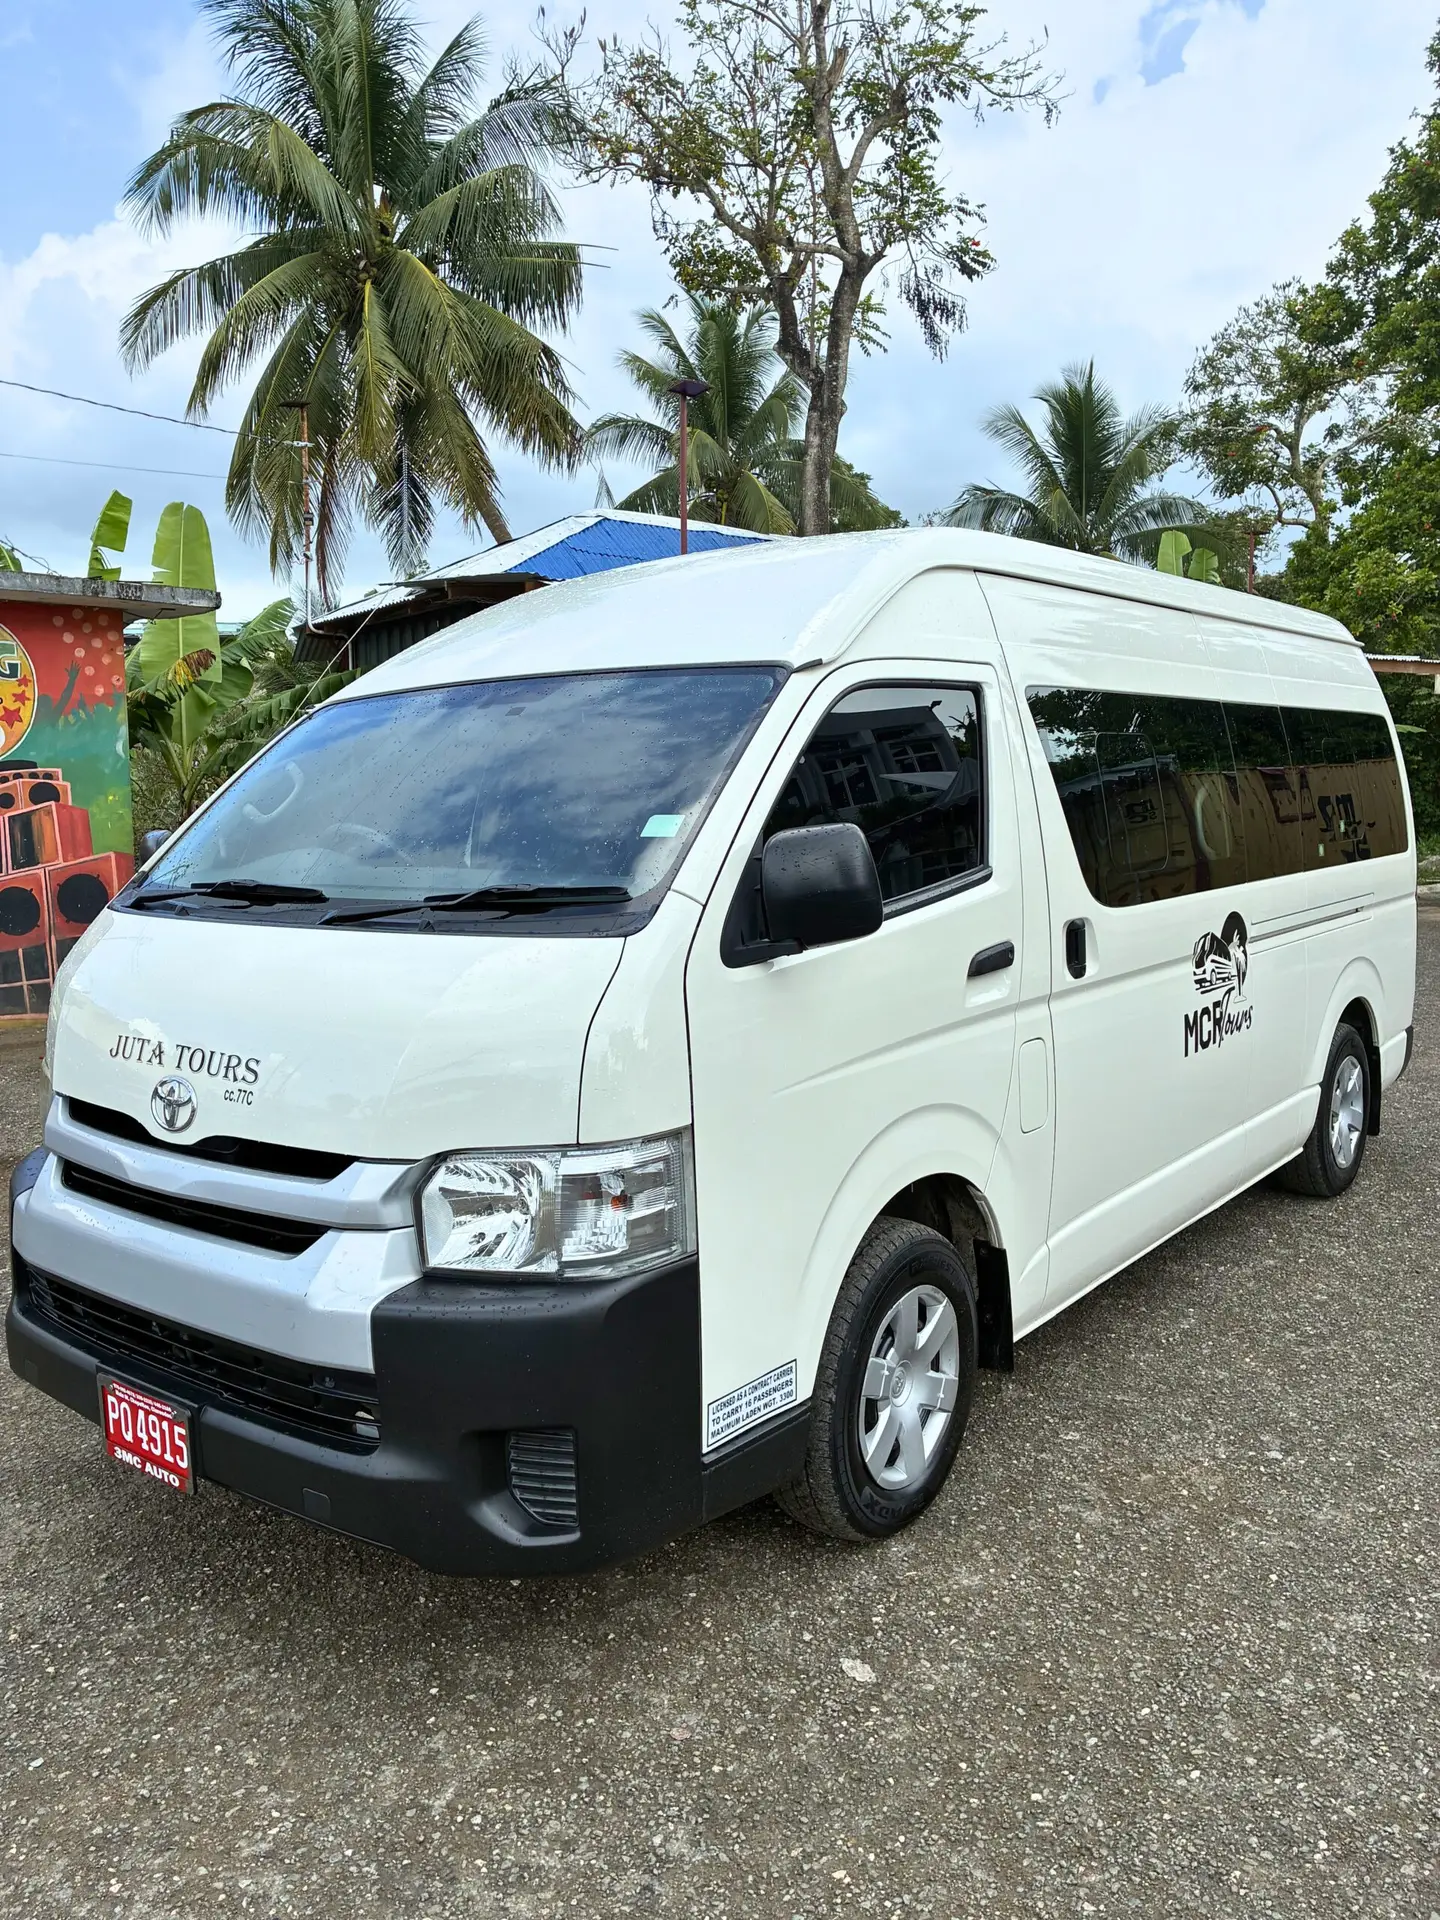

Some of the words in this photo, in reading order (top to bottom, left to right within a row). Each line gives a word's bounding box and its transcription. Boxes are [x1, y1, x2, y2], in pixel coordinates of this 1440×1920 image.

[1184, 1000, 1224, 1057] MCR
[109, 1035, 164, 1067] JUTA
[176, 1044, 261, 1084] TOURS
[711, 1416, 721, 1427] TO
[721, 1404, 744, 1422] CARRY
[744, 1398, 752, 1409] 16
[753, 1378, 794, 1404] PASSENGERS
[712, 1395, 736, 1415] LICENSED
[736, 1391, 743, 1401] AS
[747, 1375, 773, 1396] CONTRACT
[773, 1365, 794, 1383] CARRIER
[107, 1394, 133, 1443] PQ
[136, 1409, 188, 1469] 4915
[710, 1416, 741, 1439] MAXIMUM
[741, 1404, 762, 1422] LADEN
[762, 1396, 778, 1411] WGT.
[113, 1446, 142, 1469] 3MC
[145, 1461, 180, 1487] AUTO
